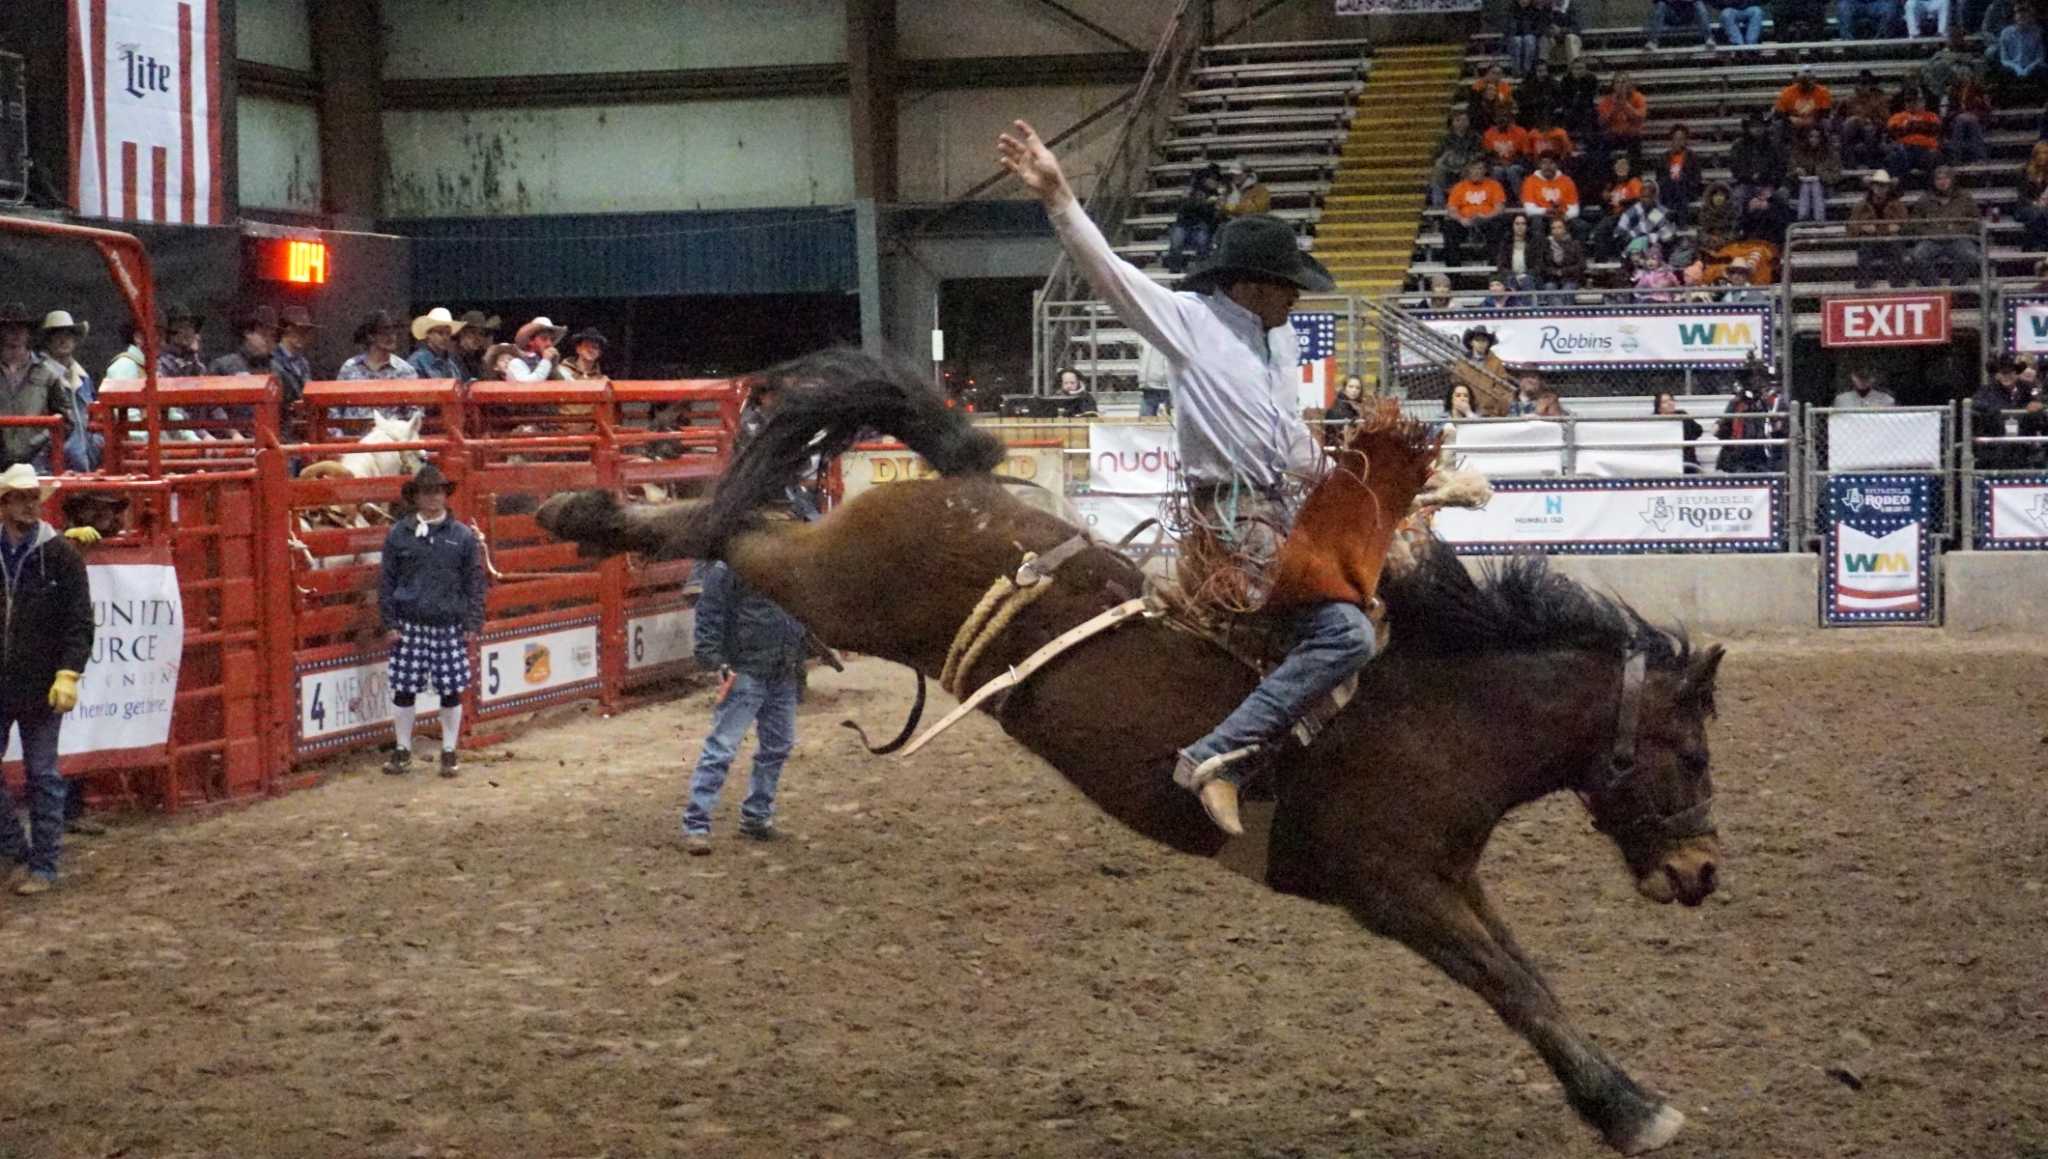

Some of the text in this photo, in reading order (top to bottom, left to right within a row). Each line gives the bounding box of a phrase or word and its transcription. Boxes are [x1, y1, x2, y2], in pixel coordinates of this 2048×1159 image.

[119, 50, 171, 99] Lite
[1678, 323, 1753, 346] WM
[1843, 303, 1931, 337] EXIT
[1540, 325, 1613, 354] Robbins
[1678, 506, 1753, 528] RODEO
[1865, 494, 1911, 509] RODEO
[1844, 552, 1911, 573] WM
[633, 625, 645, 662] 6
[488, 651, 500, 695] 5
[310, 682, 326, 731] 4
